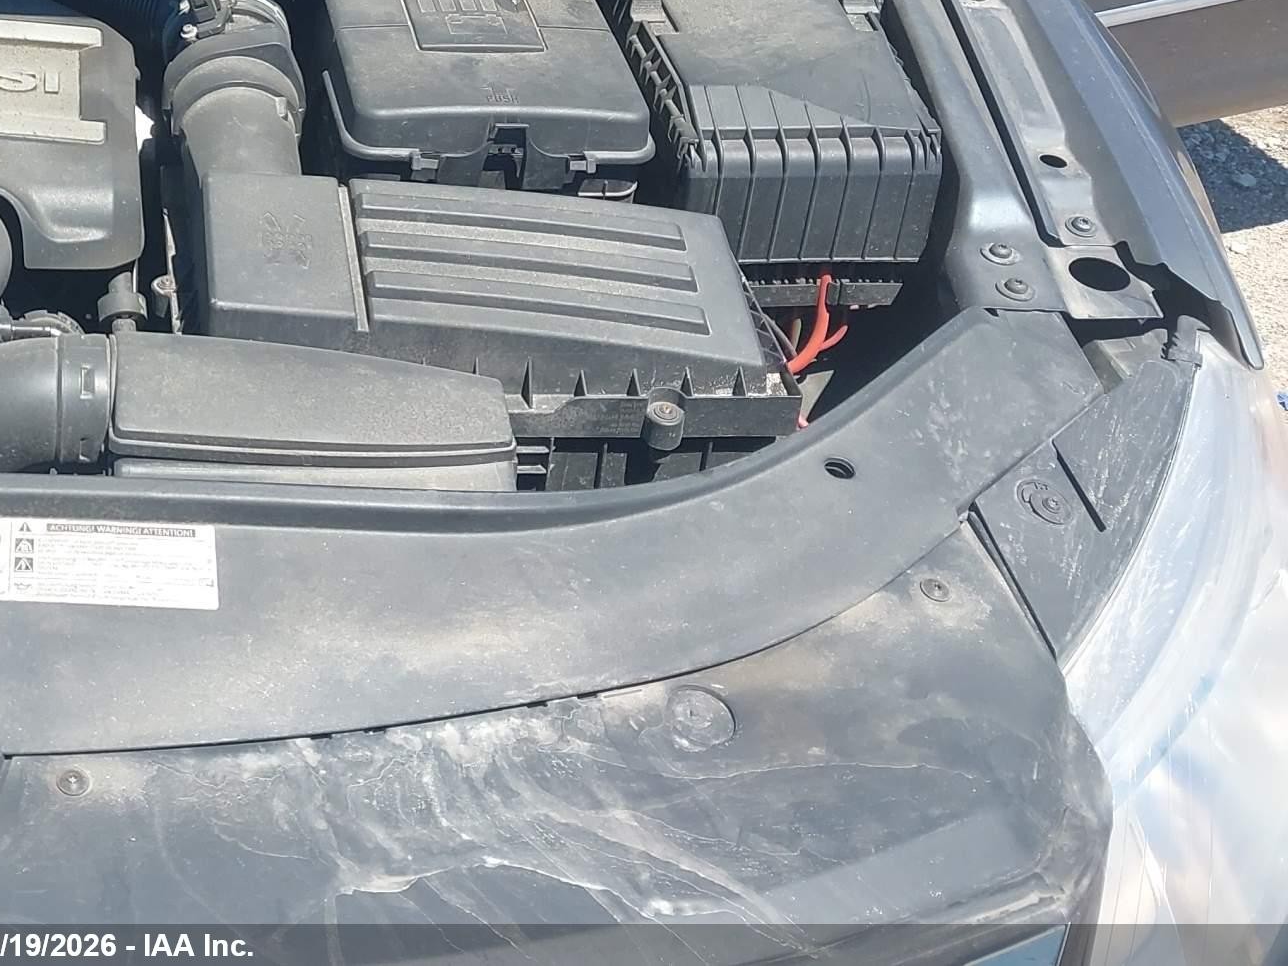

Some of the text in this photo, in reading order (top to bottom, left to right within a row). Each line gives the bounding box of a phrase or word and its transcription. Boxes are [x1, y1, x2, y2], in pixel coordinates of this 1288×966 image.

[49, 524, 195, 537] ACHTUNG! WARNING! ATTENTION!
